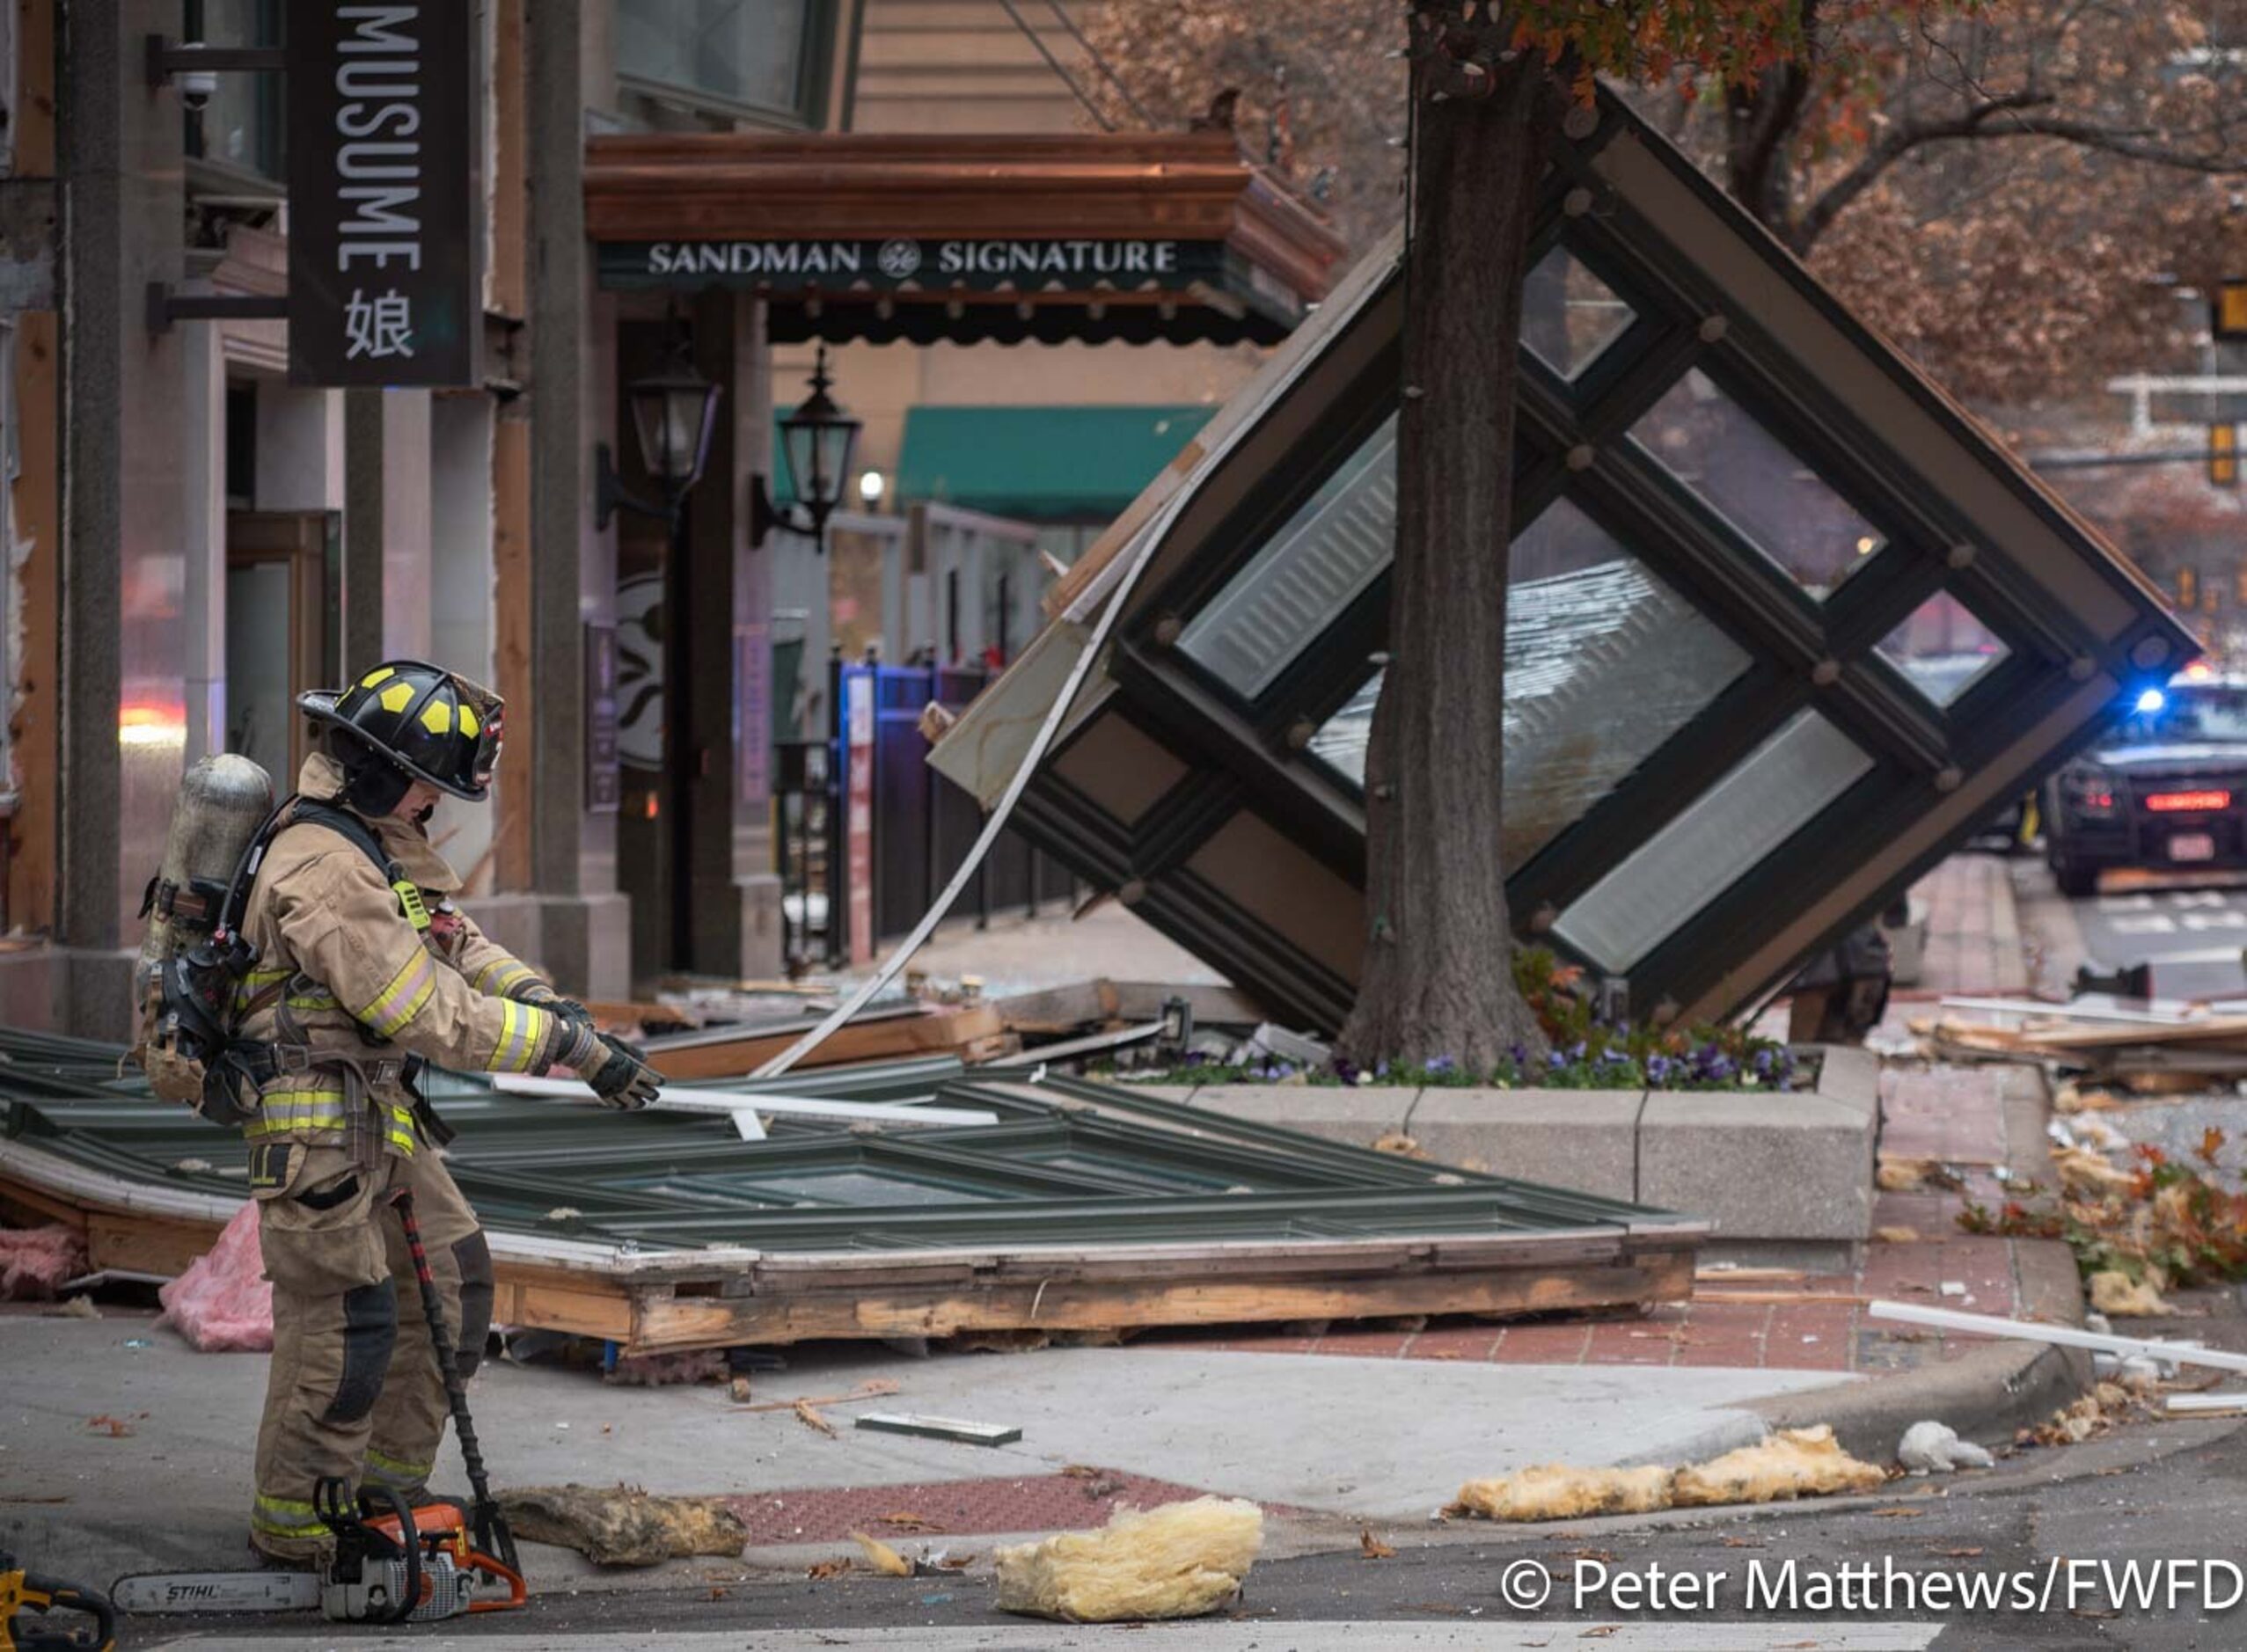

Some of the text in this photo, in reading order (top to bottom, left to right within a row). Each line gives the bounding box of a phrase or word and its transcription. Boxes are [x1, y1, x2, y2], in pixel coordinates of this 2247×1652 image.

[336, 5, 421, 273] MUSUME
[648, 241, 1176, 274] SANDMAN SIGNATURE
[344, 289, 414, 361] 娘
[166, 1584, 217, 1600] STIHL
